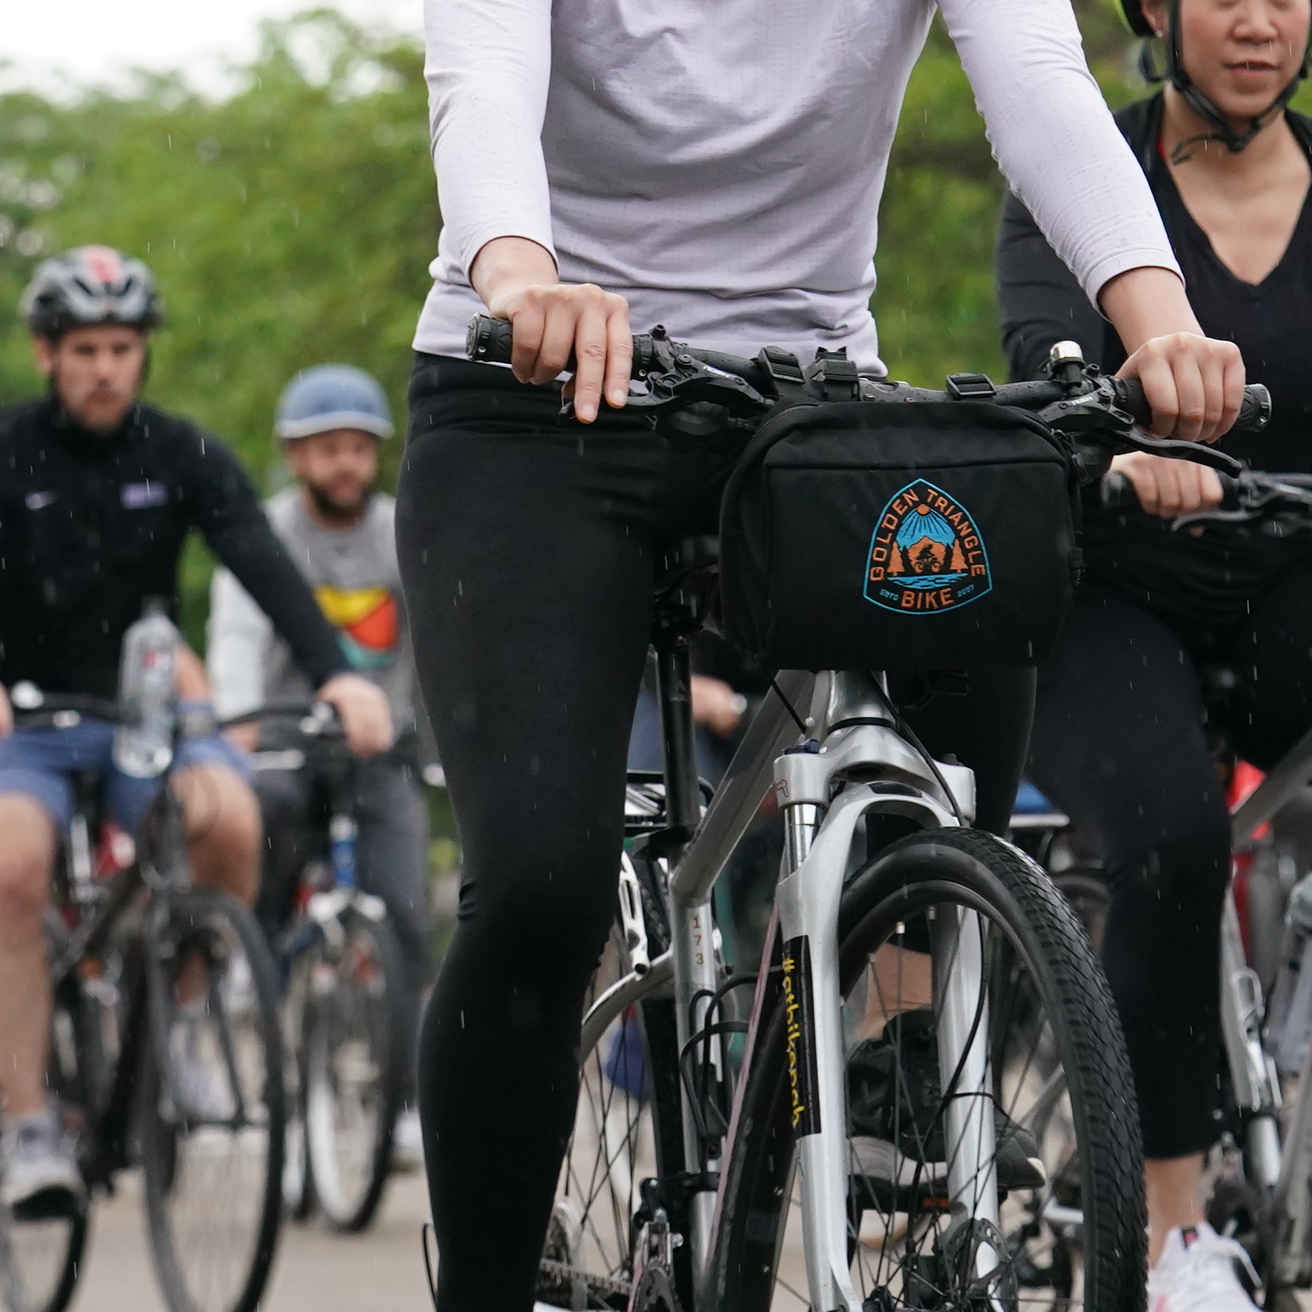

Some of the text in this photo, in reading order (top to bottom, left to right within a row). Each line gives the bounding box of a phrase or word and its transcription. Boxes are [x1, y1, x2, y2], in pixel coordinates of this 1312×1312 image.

[869, 488, 986, 581] GOLDEN TRIANGLE
[900, 587, 955, 609] BIKE
